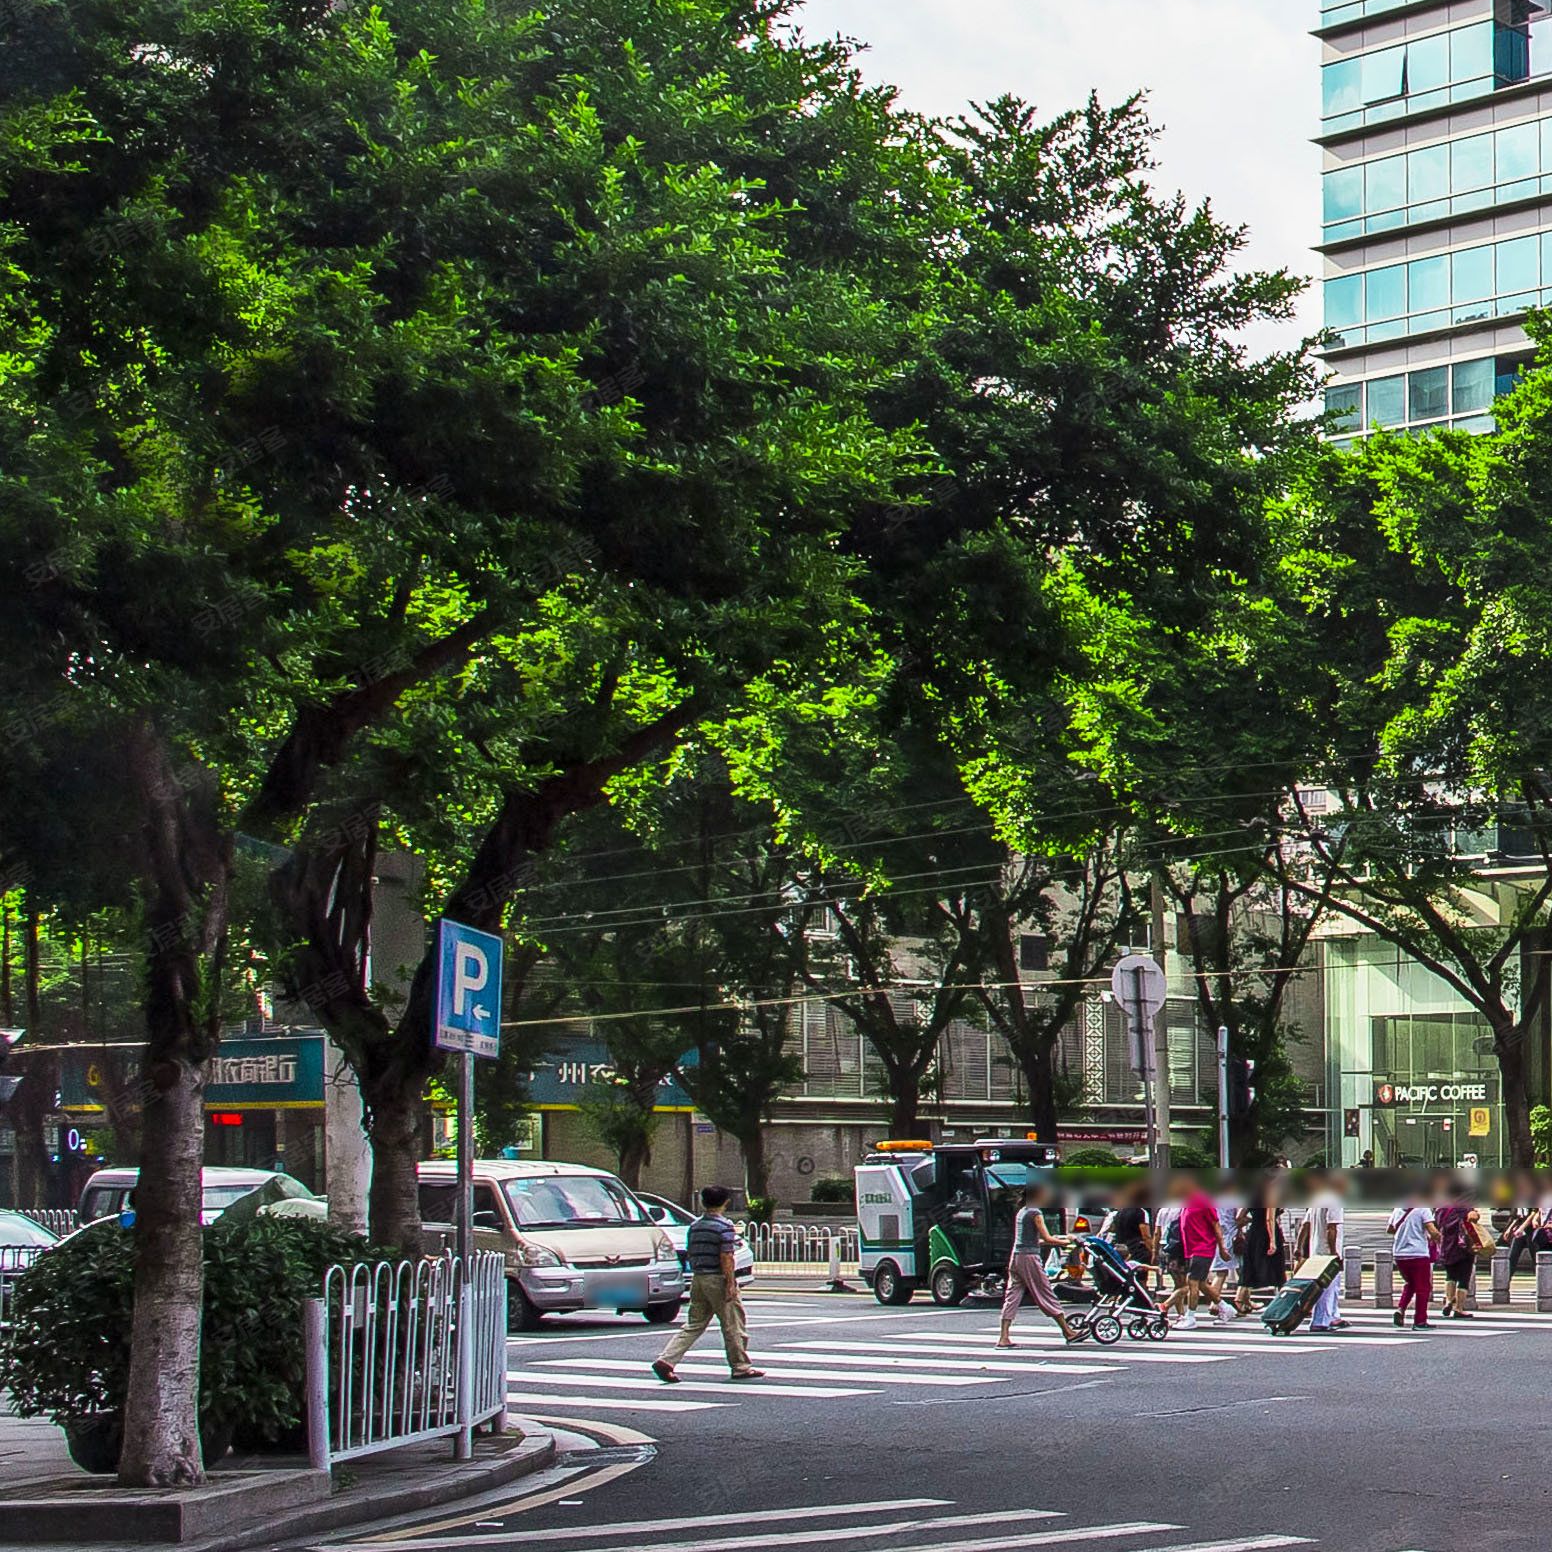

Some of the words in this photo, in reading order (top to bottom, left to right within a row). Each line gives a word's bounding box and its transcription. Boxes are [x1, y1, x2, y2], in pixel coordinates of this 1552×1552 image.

[454, 940, 489, 1016] P
[1395, 1085, 1437, 1101] PACIFIC
[1441, 1084, 1486, 1100] COFFEE
